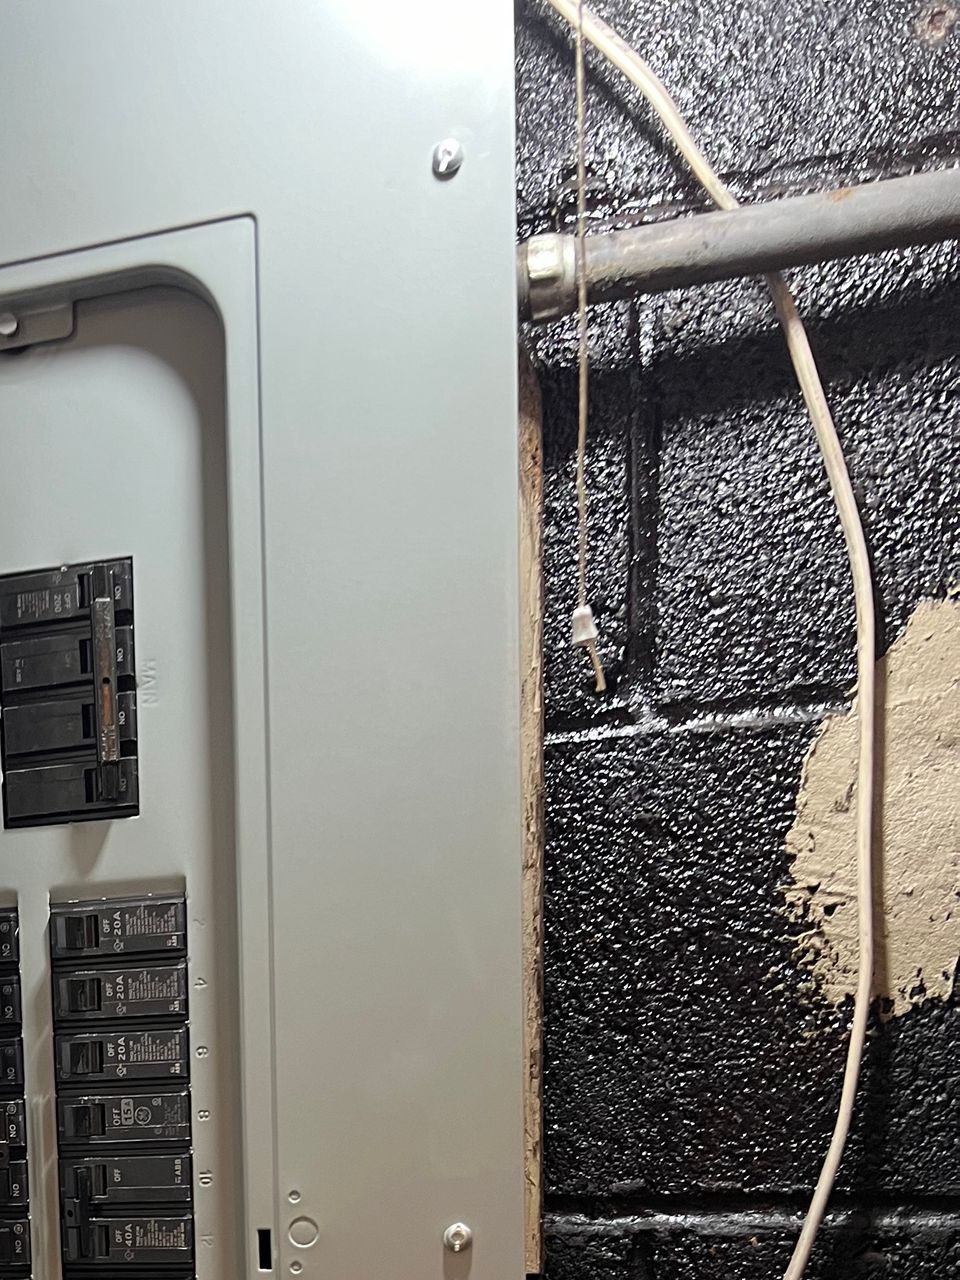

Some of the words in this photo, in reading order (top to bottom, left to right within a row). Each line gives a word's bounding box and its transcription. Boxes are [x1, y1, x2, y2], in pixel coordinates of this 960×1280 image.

[114, 586, 122, 600] ON
[116, 648, 123, 662] ON
[118, 711, 126, 725] ON
[119, 778, 127, 792] ON
[2, 943, 10, 957] ON
[5, 1006, 13, 1019] ON
[7, 1067, 16, 1080] ON
[113, 1108, 121, 1125] OFF
[123, 1100, 132, 1124] 15A
[9, 1124, 16, 1138] ON
[199, 1170, 213, 1186] 10
[13, 1184, 19, 1197] ON
[16, 1240, 22, 1254] ON
